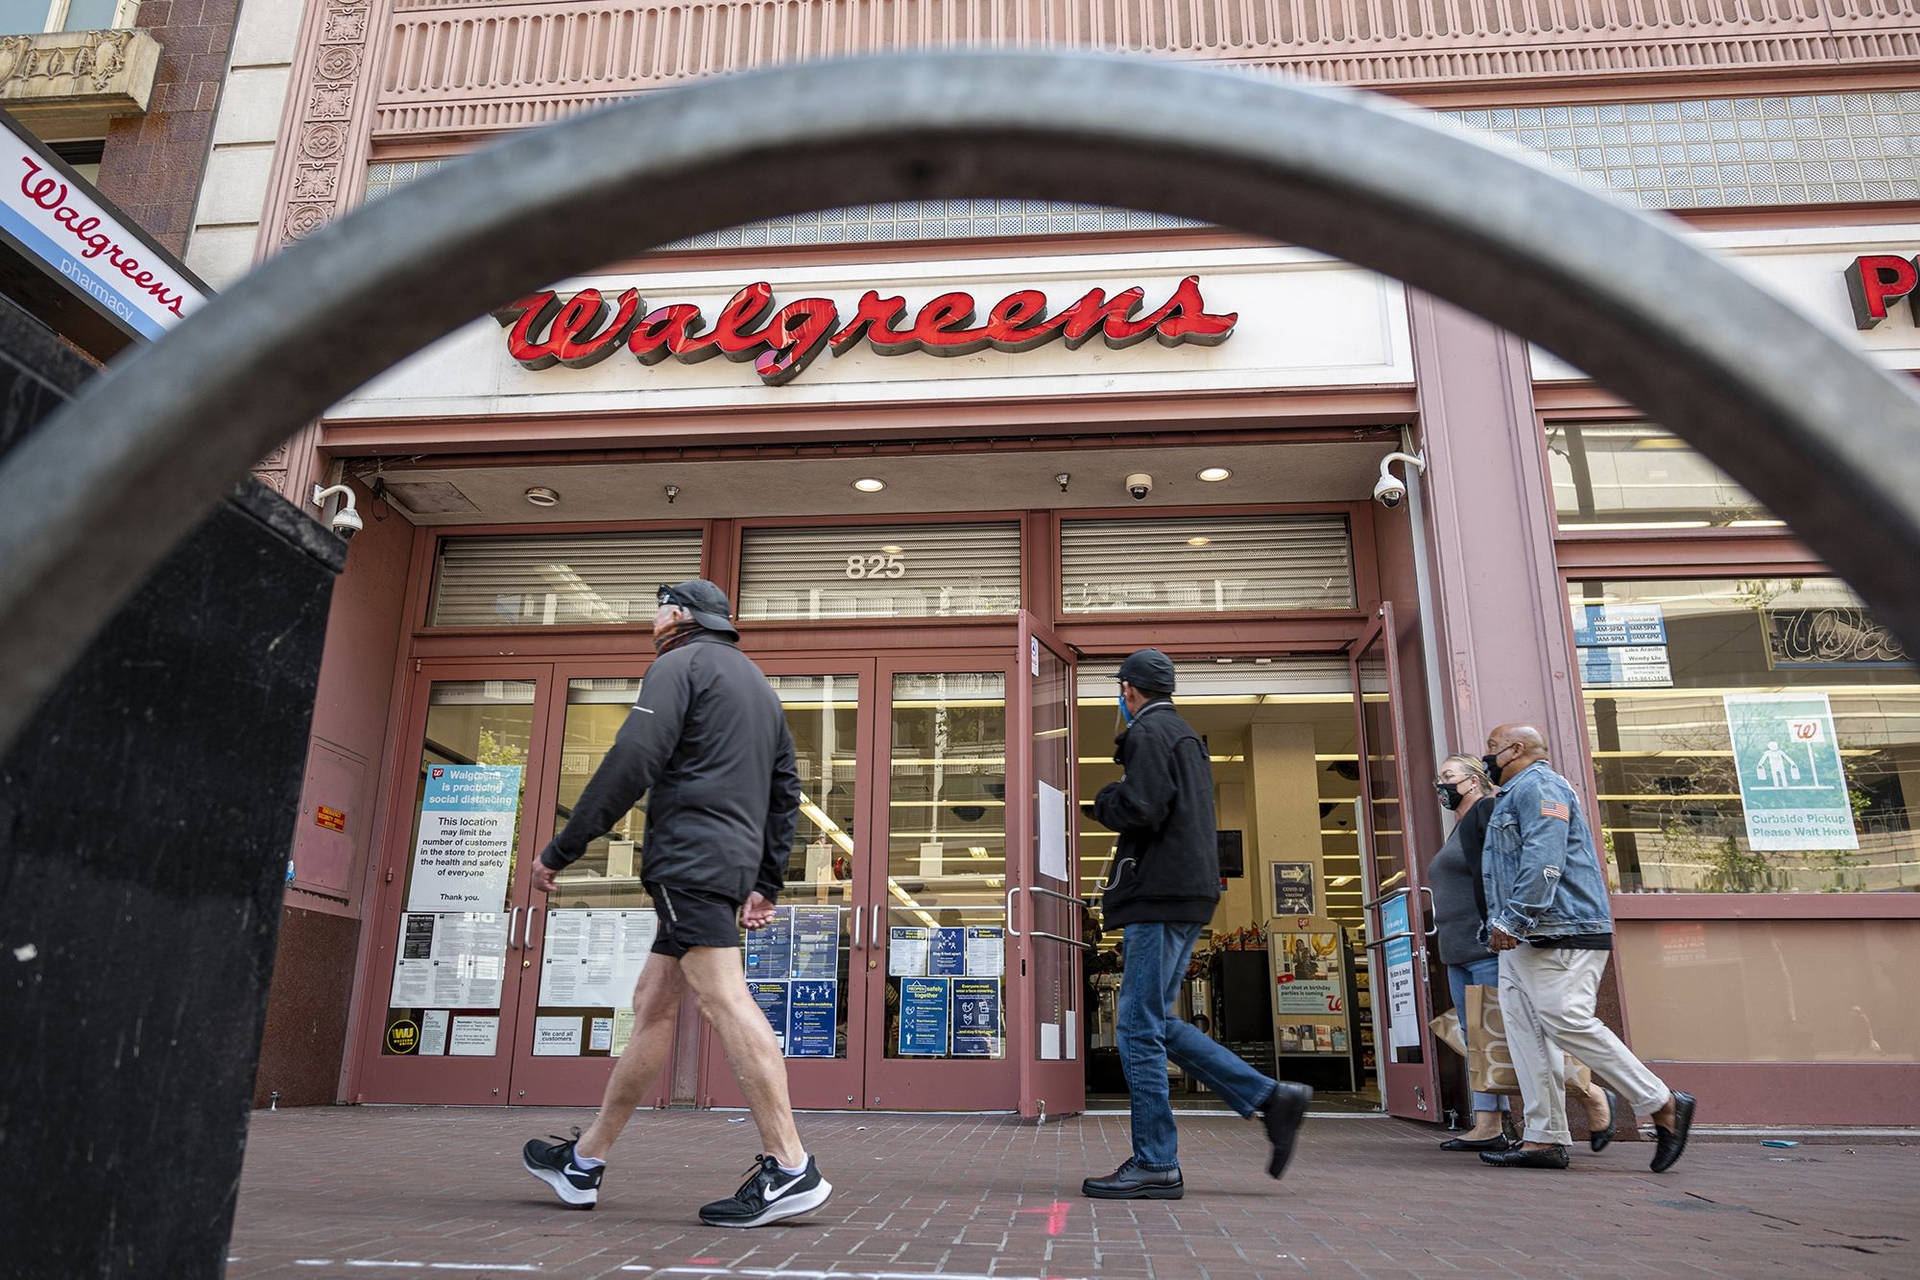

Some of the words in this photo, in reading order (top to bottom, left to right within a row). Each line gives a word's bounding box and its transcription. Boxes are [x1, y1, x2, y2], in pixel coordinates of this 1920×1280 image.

[21, 156, 185, 319] Walgreens
[60, 257, 134, 322] pharmacy
[1844, 253, 1920, 330] P
[493, 275, 1239, 387] Walgreens
[846, 554, 905, 579] 825
[442, 782, 450, 791] is
[429, 795, 458, 804] social
[461, 795, 512, 805] distancing
[438, 817, 458, 826] This
[460, 817, 498, 826] location
[1751, 815, 1803, 824] Curbside
[1807, 814, 1846, 825] Pickup
[440, 829, 457, 837] may
[459, 829, 477, 837] limit
[479, 829, 492, 837] the
[1753, 828, 1791, 837] Please
[1794, 827, 1819, 837] Wait
[1822, 827, 1850, 836] Here
[455, 838, 463, 846] of
[465, 839, 508, 847] customers
[477, 849, 507, 858] protect
[420, 858, 433, 866] the
[435, 858, 460, 866] health
[479, 859, 504, 868] safety
[448, 870, 485, 878] everyone
[440, 893, 462, 901] Thank
